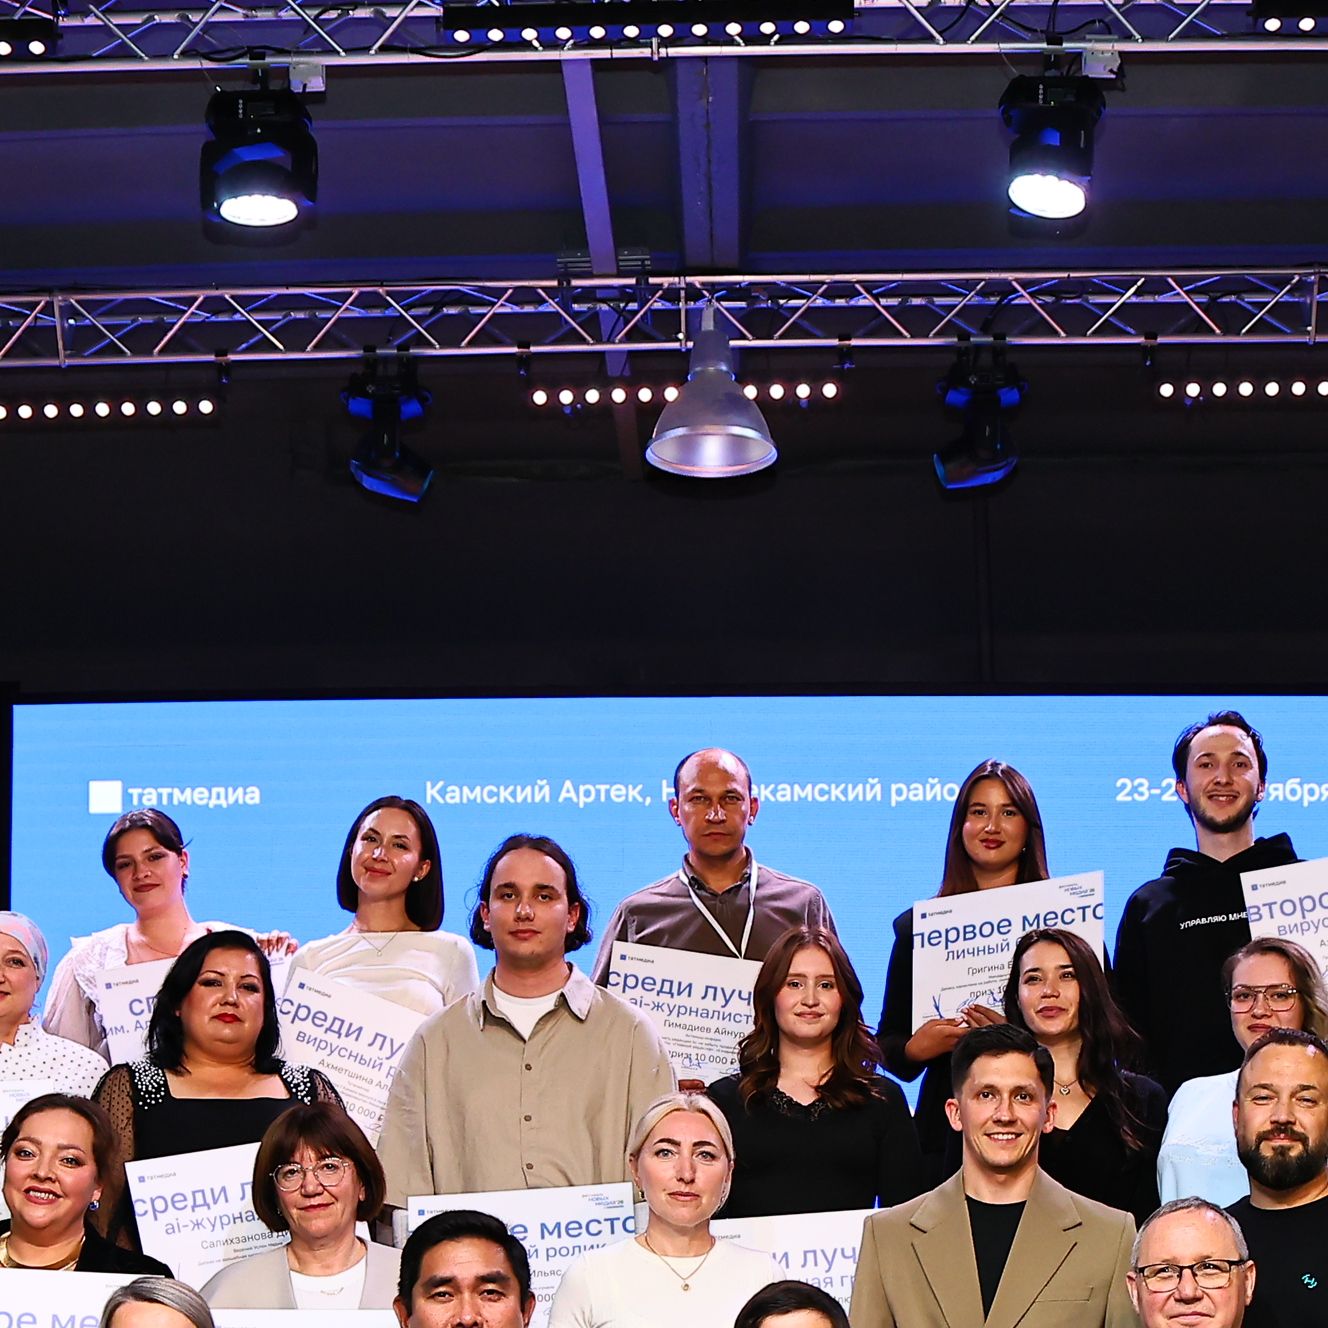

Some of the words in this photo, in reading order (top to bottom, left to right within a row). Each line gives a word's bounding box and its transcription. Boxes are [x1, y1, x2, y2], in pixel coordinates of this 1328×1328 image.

[128, 786, 261, 808] татмедиа
[426, 779, 551, 803] Камский
[559, 779, 651, 807] Артек,
[662, 778, 881, 802] Нкамский
[891, 778, 962, 808] райо
[1116, 779, 1177, 801] 23-2
[913, 918, 1012, 949] первое
[1022, 903, 1103, 932] место
[1180, 915, 1227, 930] УПРАВЛЯЮ
[946, 939, 1009, 961] личный
[967, 964, 1004, 976] Григина
[608, 971, 692, 998] среди
[701, 984, 752, 1008] луч
[279, 998, 364, 1042] среди
[630, 997, 752, 1025] ai-журналист
[664, 1019, 712, 1033] Гимадиев
[714, 1027, 745, 1040] Айнур
[296, 1030, 384, 1071] вирусный
[695, 1053, 706, 1061] 10
[709, 1055, 727, 1064] 000
[318, 1059, 373, 1085] Ахметшина
[357, 1106, 376, 1119] 000
[134, 1186, 229, 1221] среди
[540, 1215, 635, 1240] место
[201, 1231, 273, 1250] Салихзанова
[801, 1247, 858, 1273] луч
[530, 1269, 562, 1277] Ильяс
